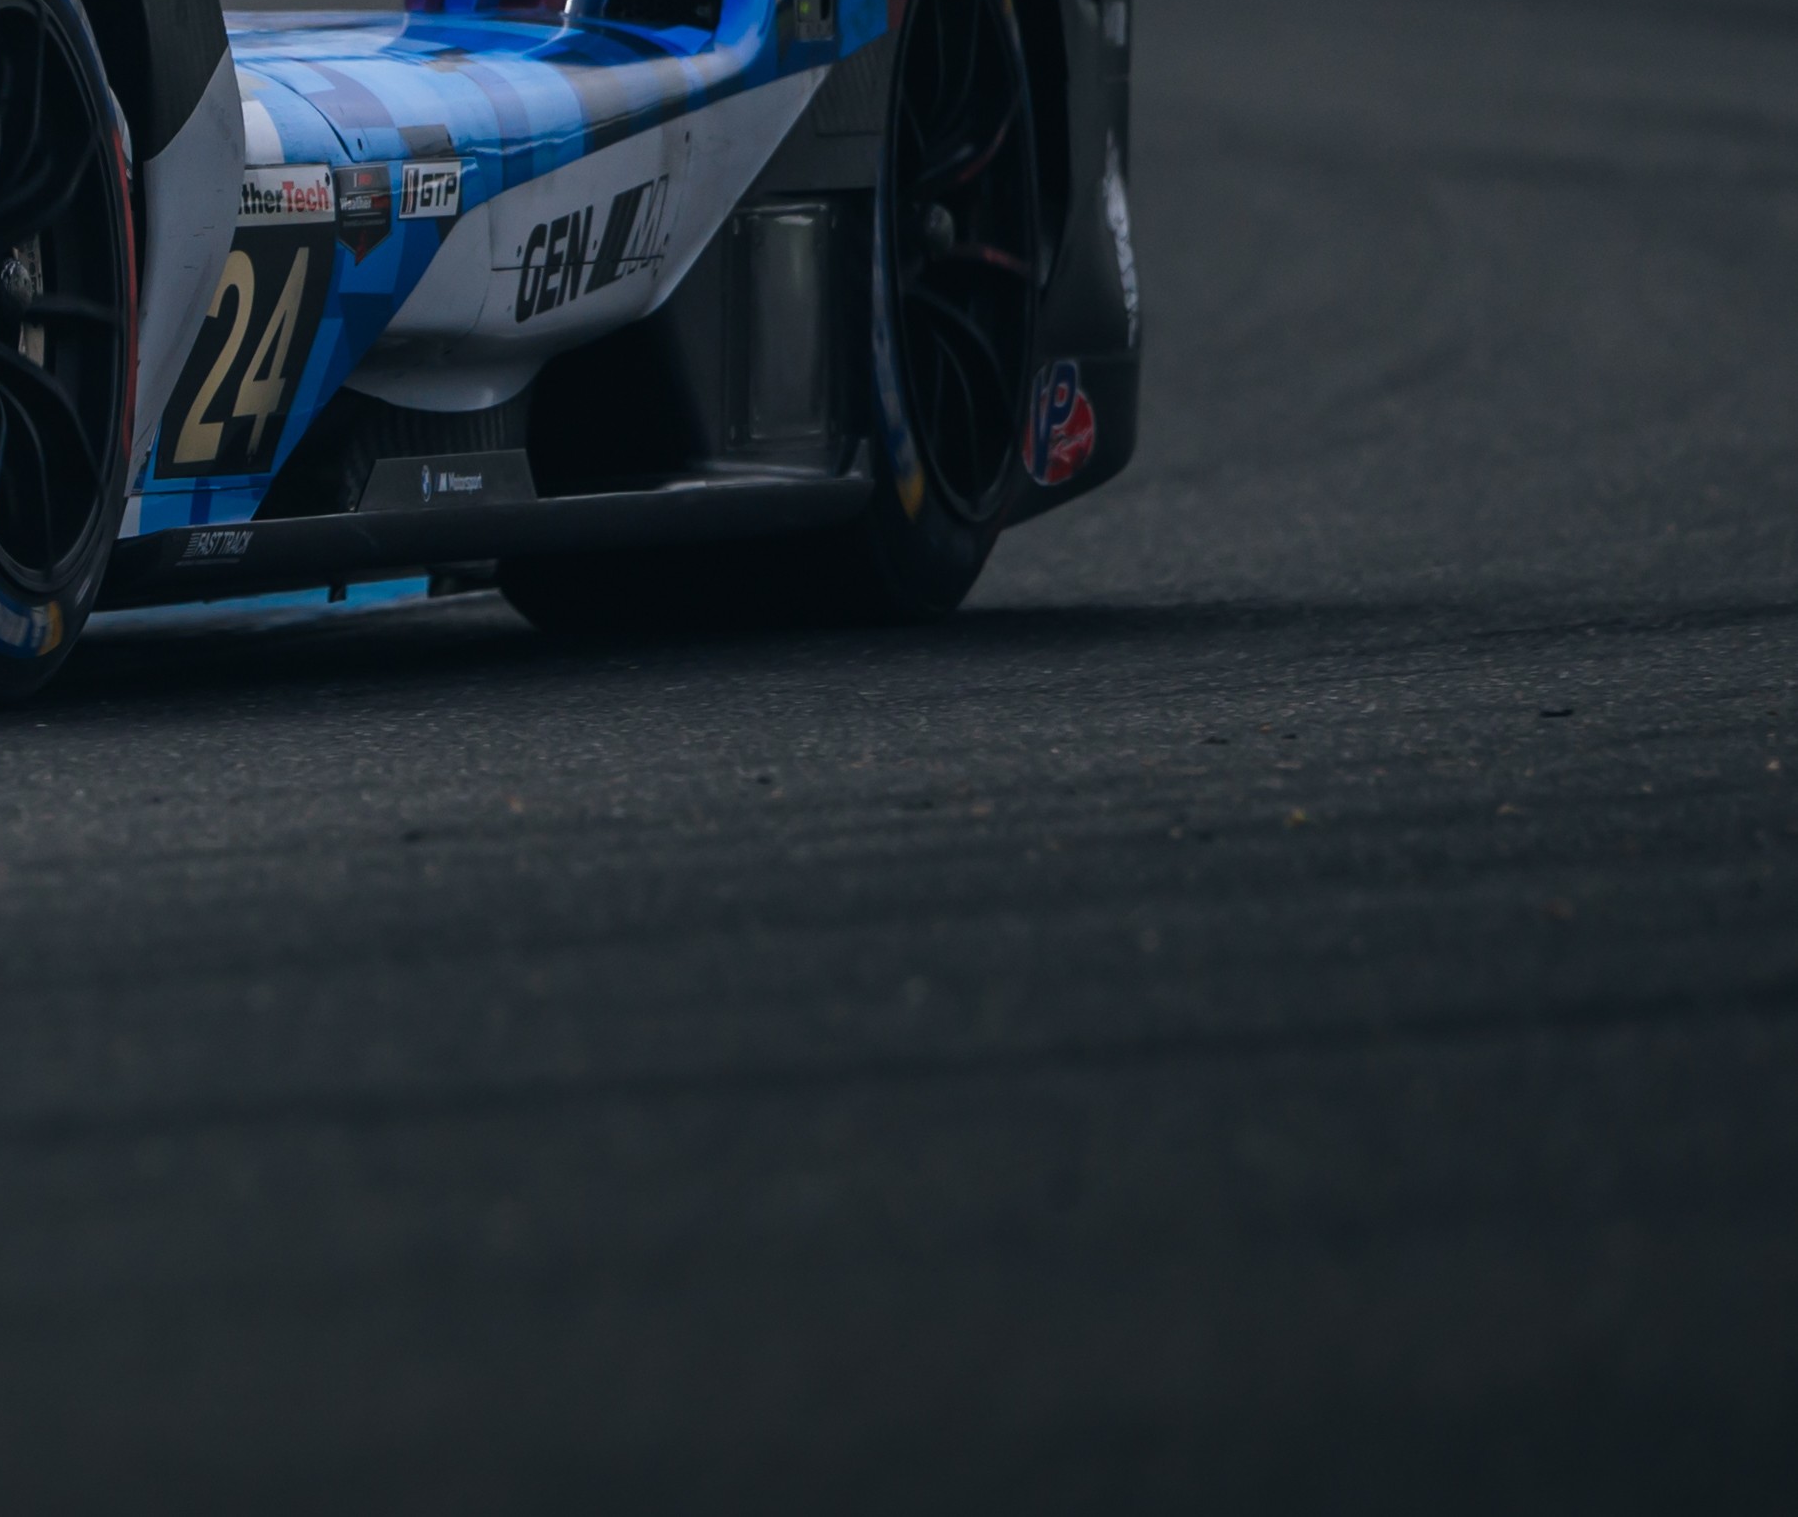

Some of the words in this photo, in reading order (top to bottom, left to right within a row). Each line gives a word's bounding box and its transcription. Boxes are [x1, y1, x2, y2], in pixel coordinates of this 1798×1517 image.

[238, 181, 330, 215] therTech
[420, 172, 458, 208] GTP
[515, 205, 594, 324] GEN
[173, 247, 310, 464] 24
